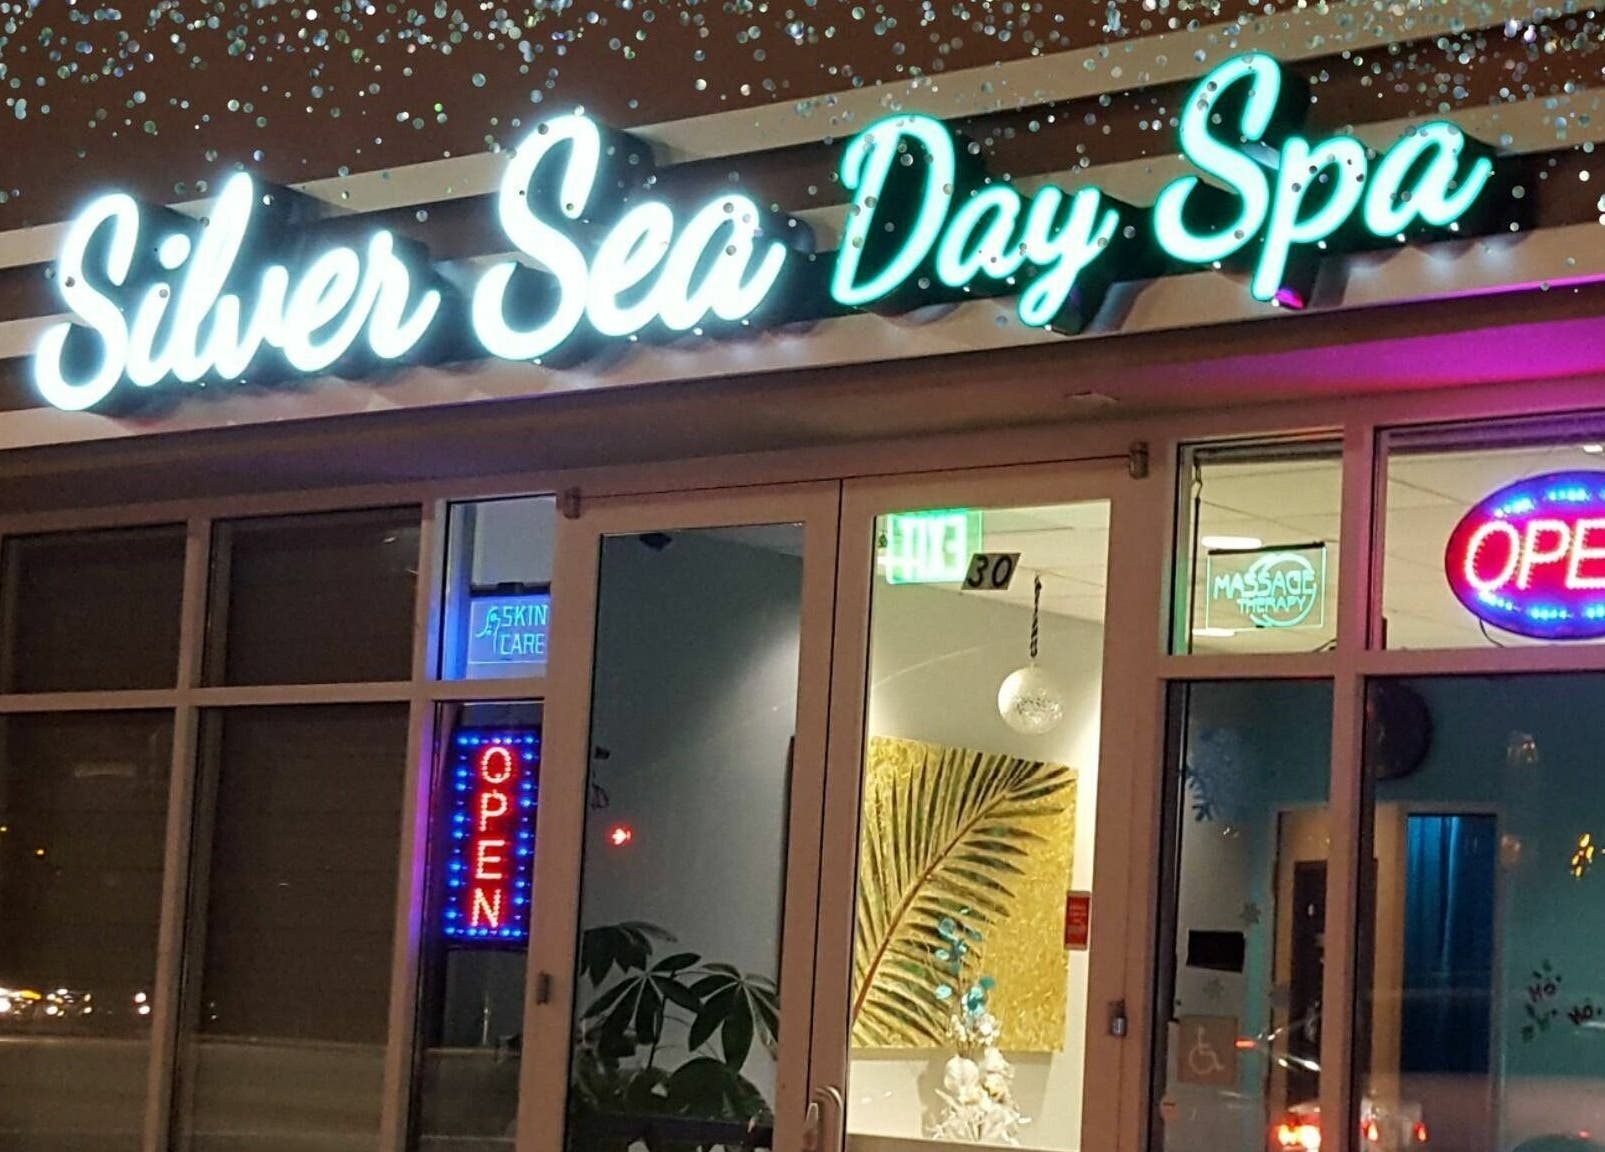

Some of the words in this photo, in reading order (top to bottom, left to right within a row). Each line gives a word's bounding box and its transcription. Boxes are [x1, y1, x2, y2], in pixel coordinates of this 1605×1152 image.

[33, 171, 441, 411] Silver
[471, 110, 787, 361] Sea
[830, 114, 1119, 328] Day
[1153, 51, 1493, 302] Spa
[967, 553, 1013, 588] 30
[1213, 570, 1316, 600] MASSAGE
[501, 604, 549, 627] SKIN
[1237, 595, 1306, 614] THERAPY
[501, 632, 545, 655] CARE
[471, 745, 512, 929] OPEN
